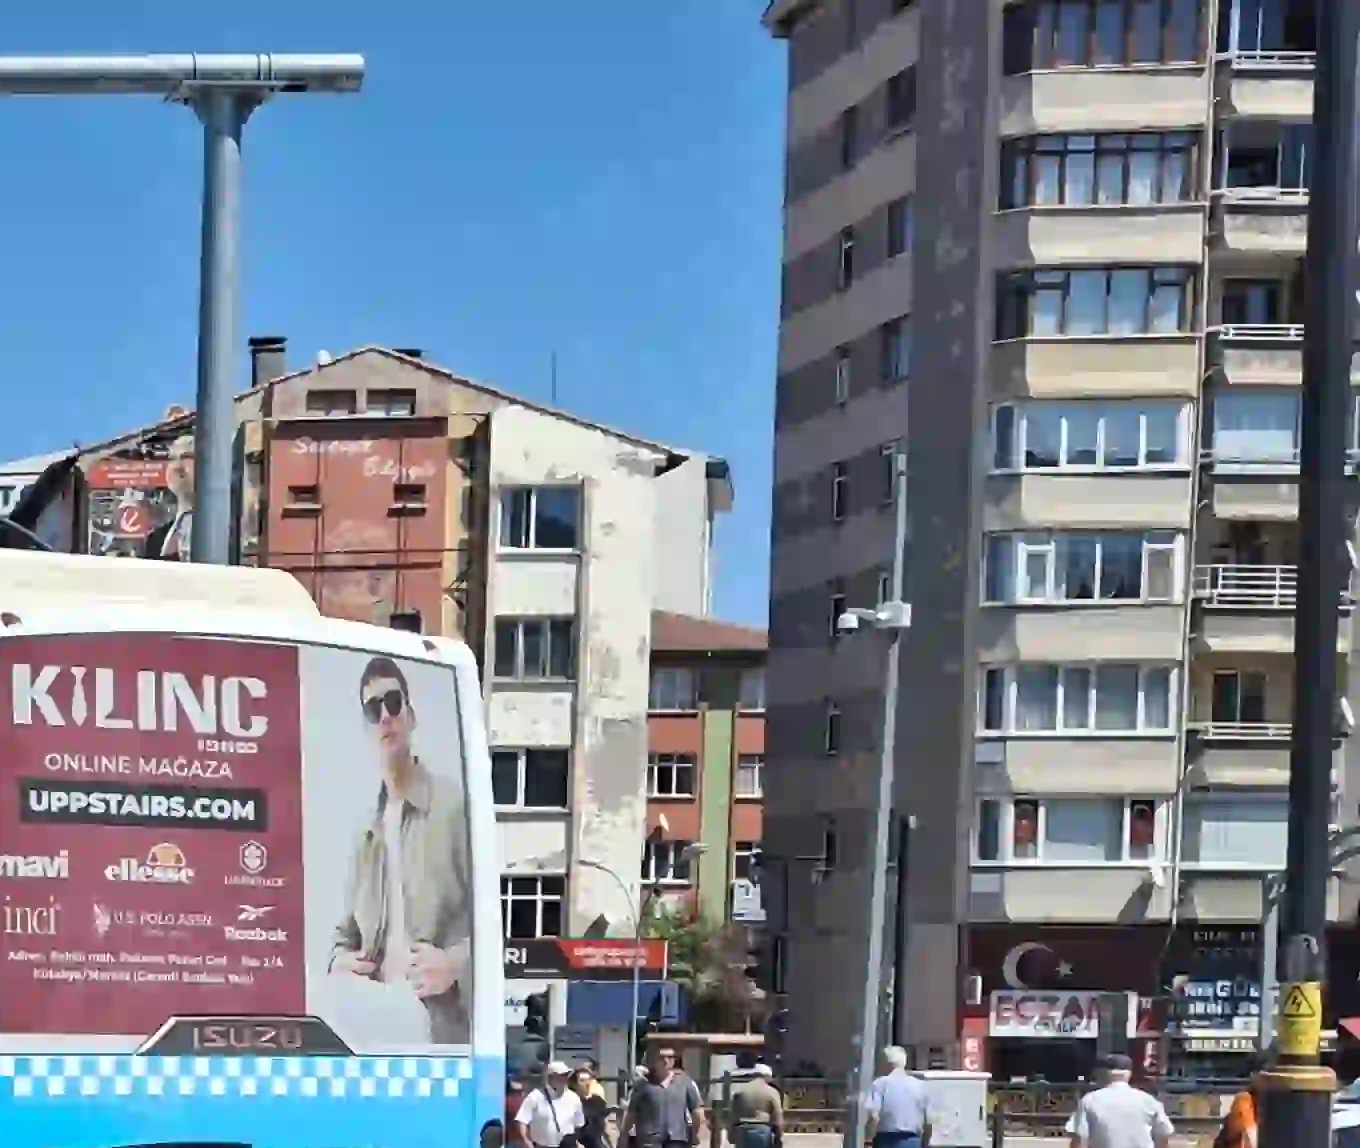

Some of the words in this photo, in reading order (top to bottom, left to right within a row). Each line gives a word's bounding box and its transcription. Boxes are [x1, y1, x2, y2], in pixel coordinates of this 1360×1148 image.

[44, 753, 132, 774] ONLINE
[29, 788, 256, 821] UPPSTAIRS.COM
[104, 857, 195, 884] ellesse
[4, 894, 57, 935] inci
[194, 1026, 303, 1048] ISUZU
